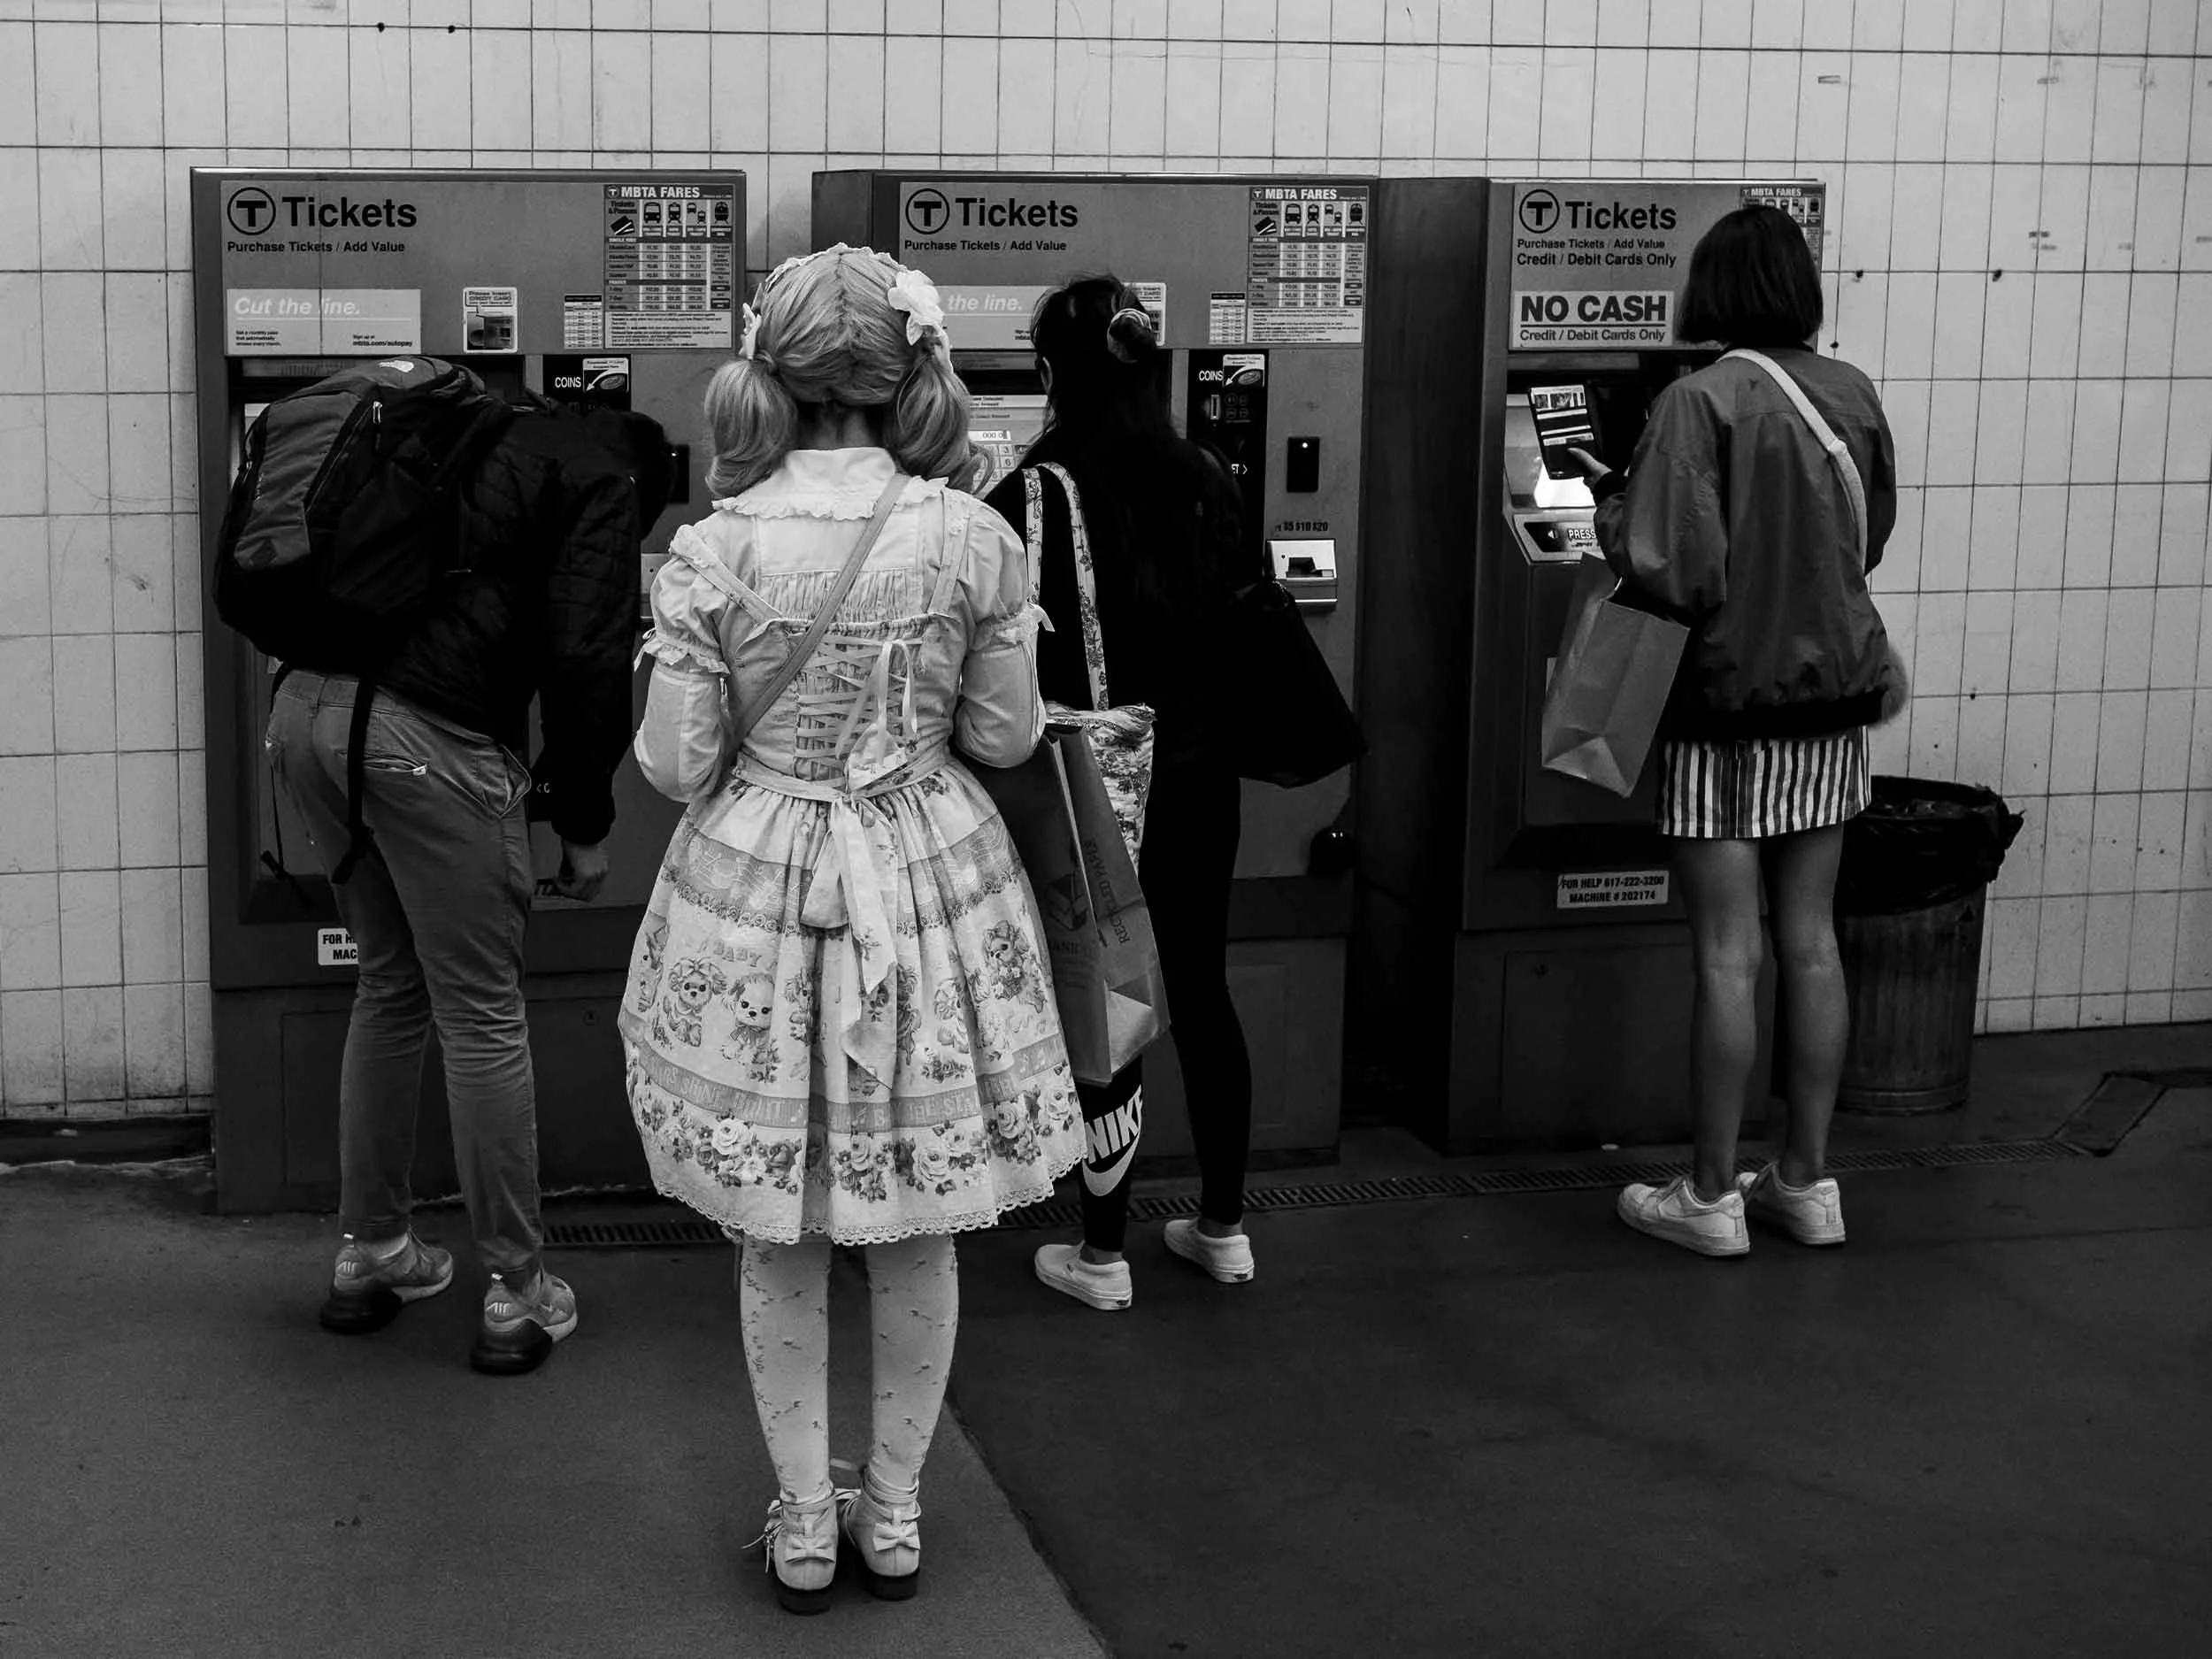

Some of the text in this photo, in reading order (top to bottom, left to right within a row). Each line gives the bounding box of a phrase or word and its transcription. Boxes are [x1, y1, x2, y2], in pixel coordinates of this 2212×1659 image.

[621, 187, 657, 198] MBTA
[660, 187, 700, 198] FARES
[1265, 188, 1297, 199] MBTA
[1301, 188, 1337, 199] FARES
[1776, 188, 1801, 196] FARES
[282, 196, 417, 227] Tickets
[956, 197, 1078, 227] Tickets
[1565, 202, 1677, 230] Tickets
[227, 242, 404, 252] Purchase Tickets / Add Value
[904, 241, 1066, 251] Purchase Tickets / Add Value
[1517, 239, 1565, 249] Purchase
[1569, 239, 1604, 249] Tickets
[1614, 239, 1633, 249] Add
[1637, 239, 1665, 249] Value
[1517, 253, 1677, 268] Credit / Debit Cards Only
[234, 296, 360, 316] Cut the line.
[948, 296, 1023, 311] the line.
[1521, 296, 1666, 322] NO CASH
[1520, 330, 1665, 342] Credit / Debit Cards Only
[1199, 370, 1224, 381] COINS
[556, 376, 581, 388] COINS
[1296, 522, 1311, 532] $10
[1569, 530, 1597, 539] PRESS
[1562, 879, 1578, 889] FOR
[1580, 878, 1602, 888] HELP
[1570, 892, 1611, 903] MACHINE
[323, 933, 342, 944] FOR
[1085, 1084, 1142, 1164] NIK
